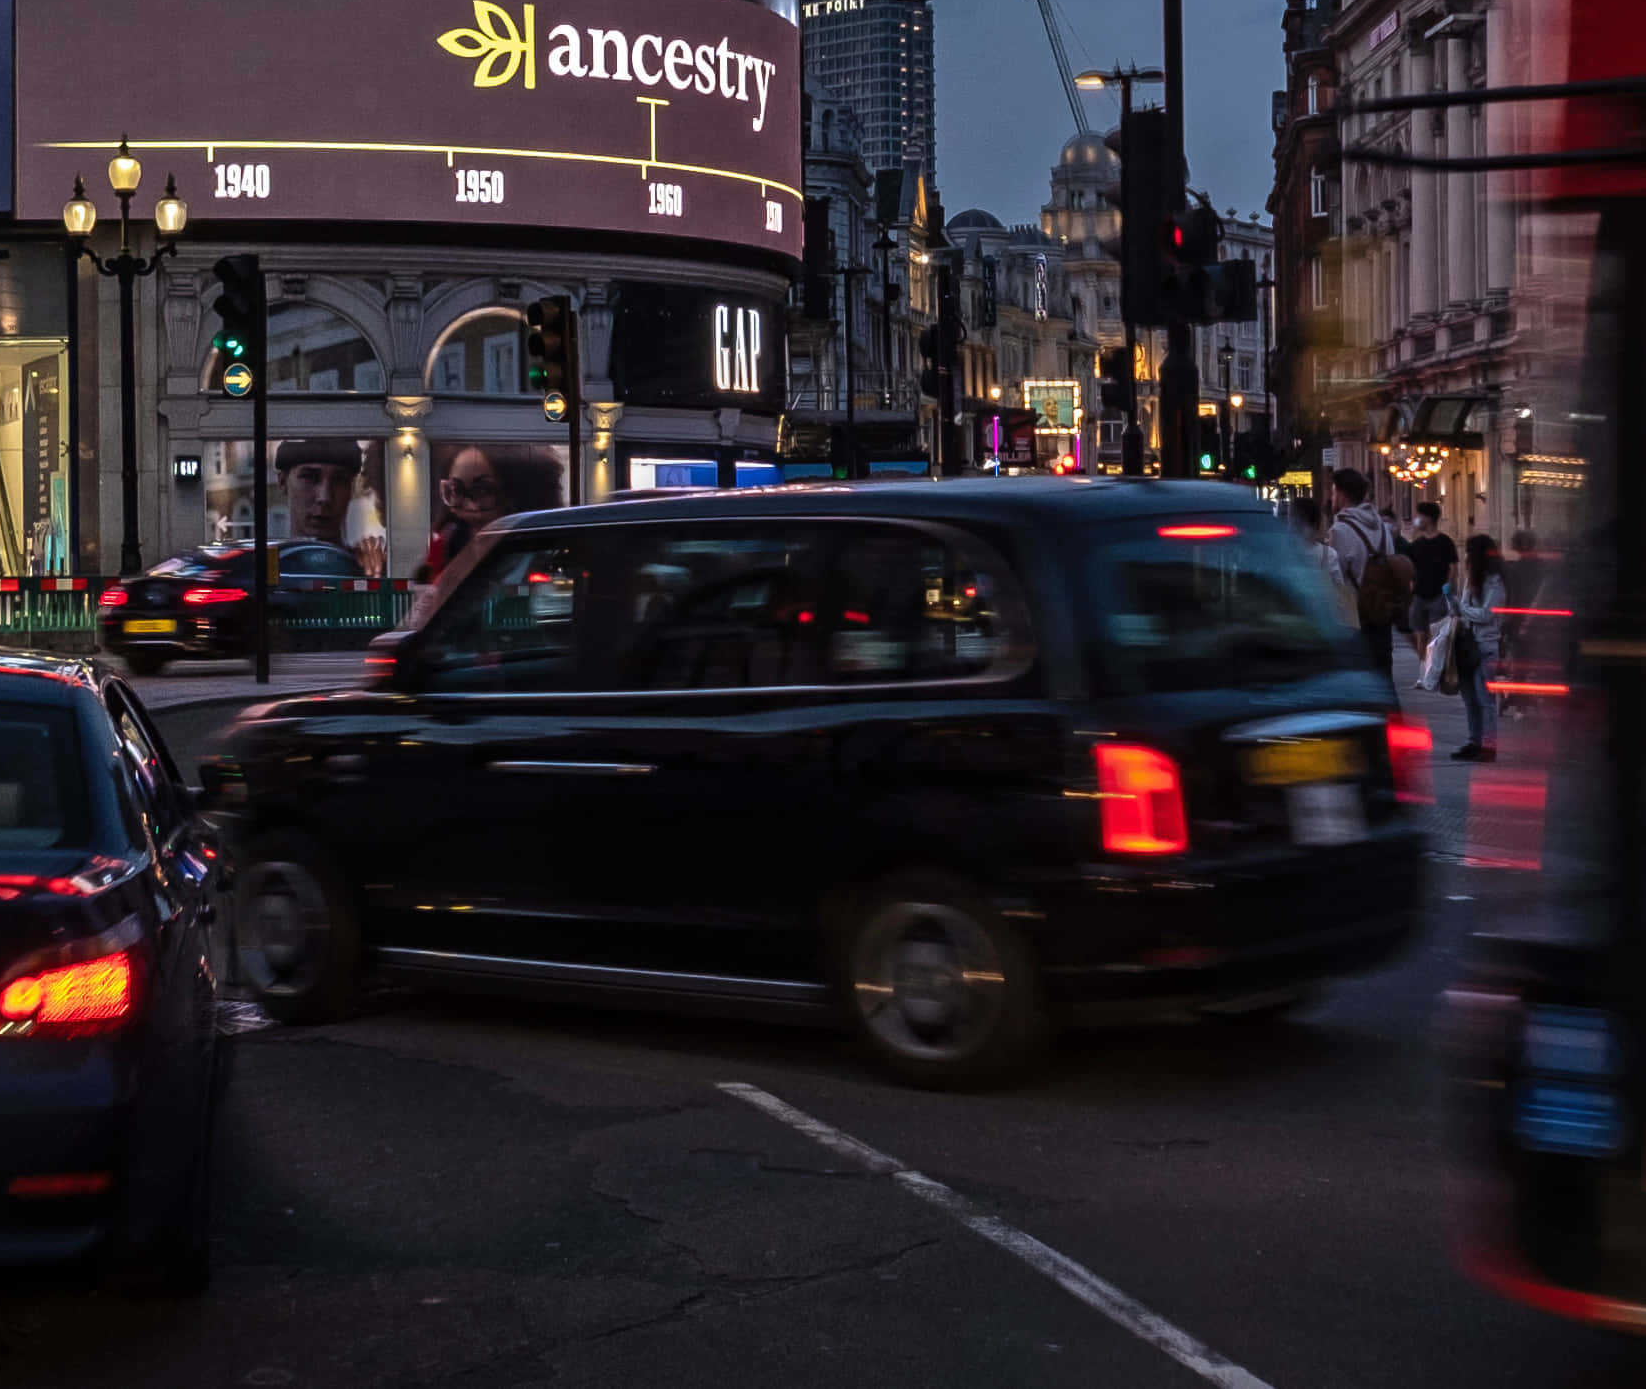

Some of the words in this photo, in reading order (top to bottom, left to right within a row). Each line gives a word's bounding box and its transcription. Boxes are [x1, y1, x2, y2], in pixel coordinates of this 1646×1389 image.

[548, 21, 776, 132] ancestry
[214, 165, 270, 199] 1940
[455, 169, 505, 204] 1950
[648, 182, 683, 217] 1960
[715, 305, 761, 393] GAP
